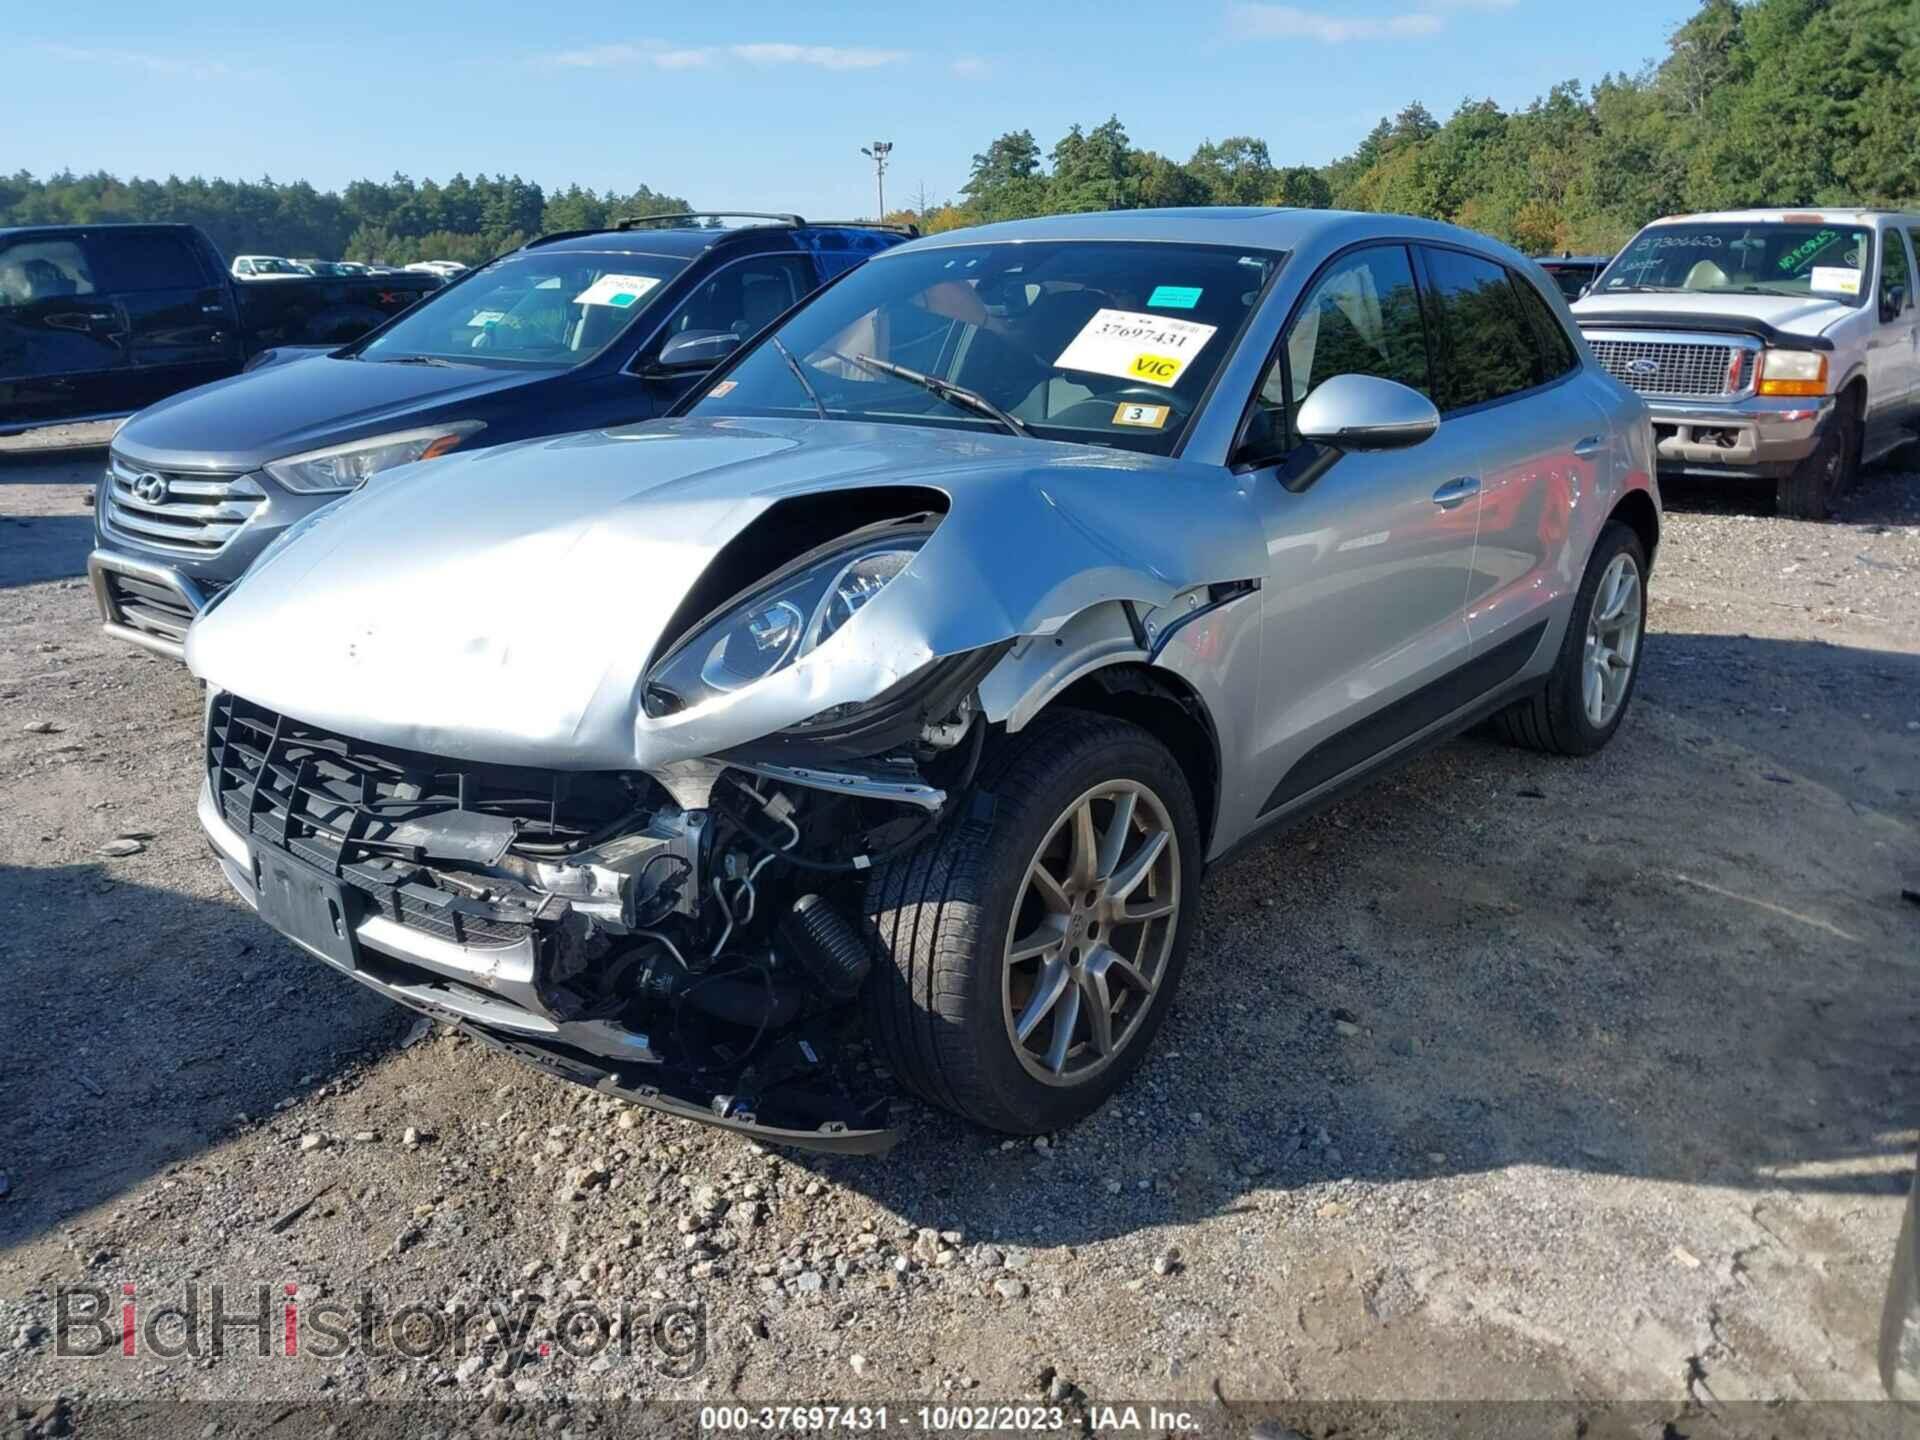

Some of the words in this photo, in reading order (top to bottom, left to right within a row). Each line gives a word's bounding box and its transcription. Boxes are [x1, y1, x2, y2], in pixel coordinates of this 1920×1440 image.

[1096, 323, 1187, 347] 37697431
[1136, 358, 1176, 378] VIC
[1129, 407, 1144, 421] 3
